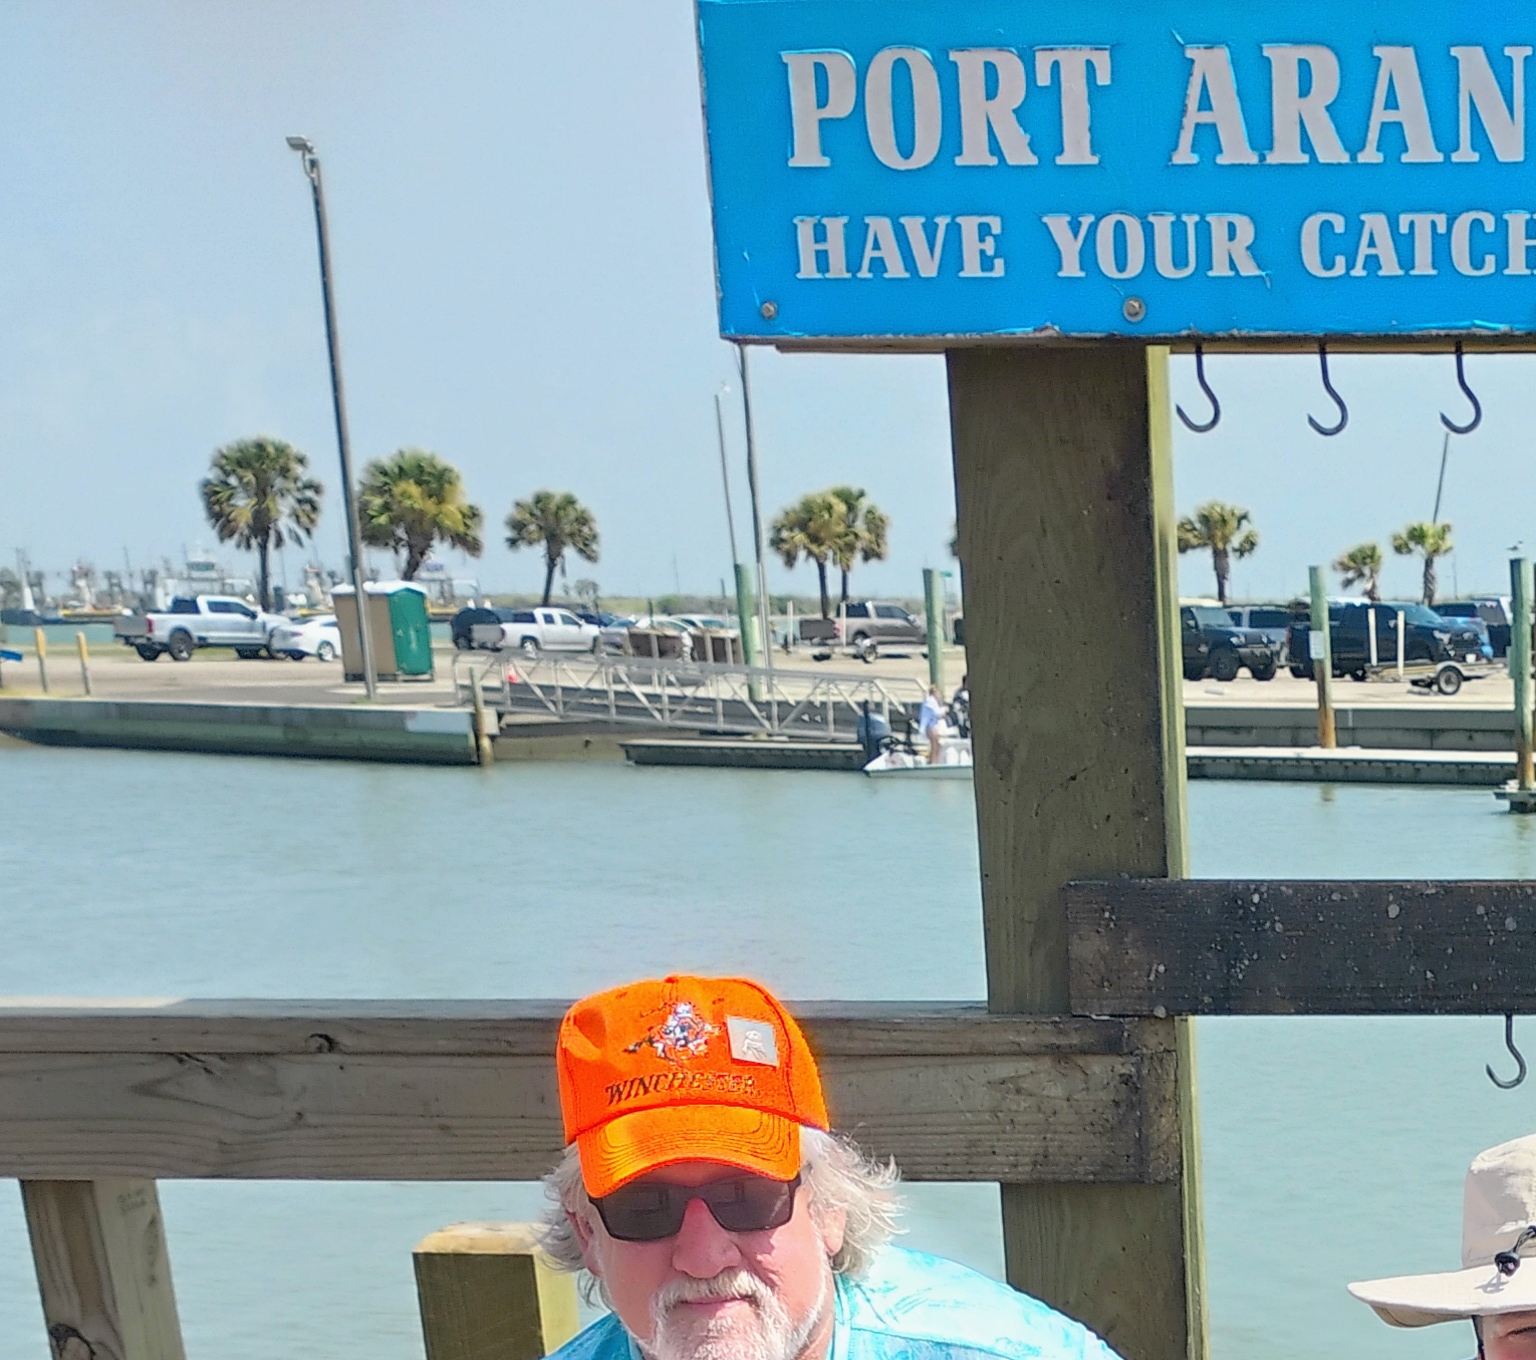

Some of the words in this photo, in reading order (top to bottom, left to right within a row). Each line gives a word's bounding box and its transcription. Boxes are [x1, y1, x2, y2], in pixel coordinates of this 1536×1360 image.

[782, 46, 1111, 170] PORT
[794, 215, 1005, 280] HAVE
[1042, 212, 1262, 279] YOUR
[605, 1071, 756, 1106] WINCHESTER
